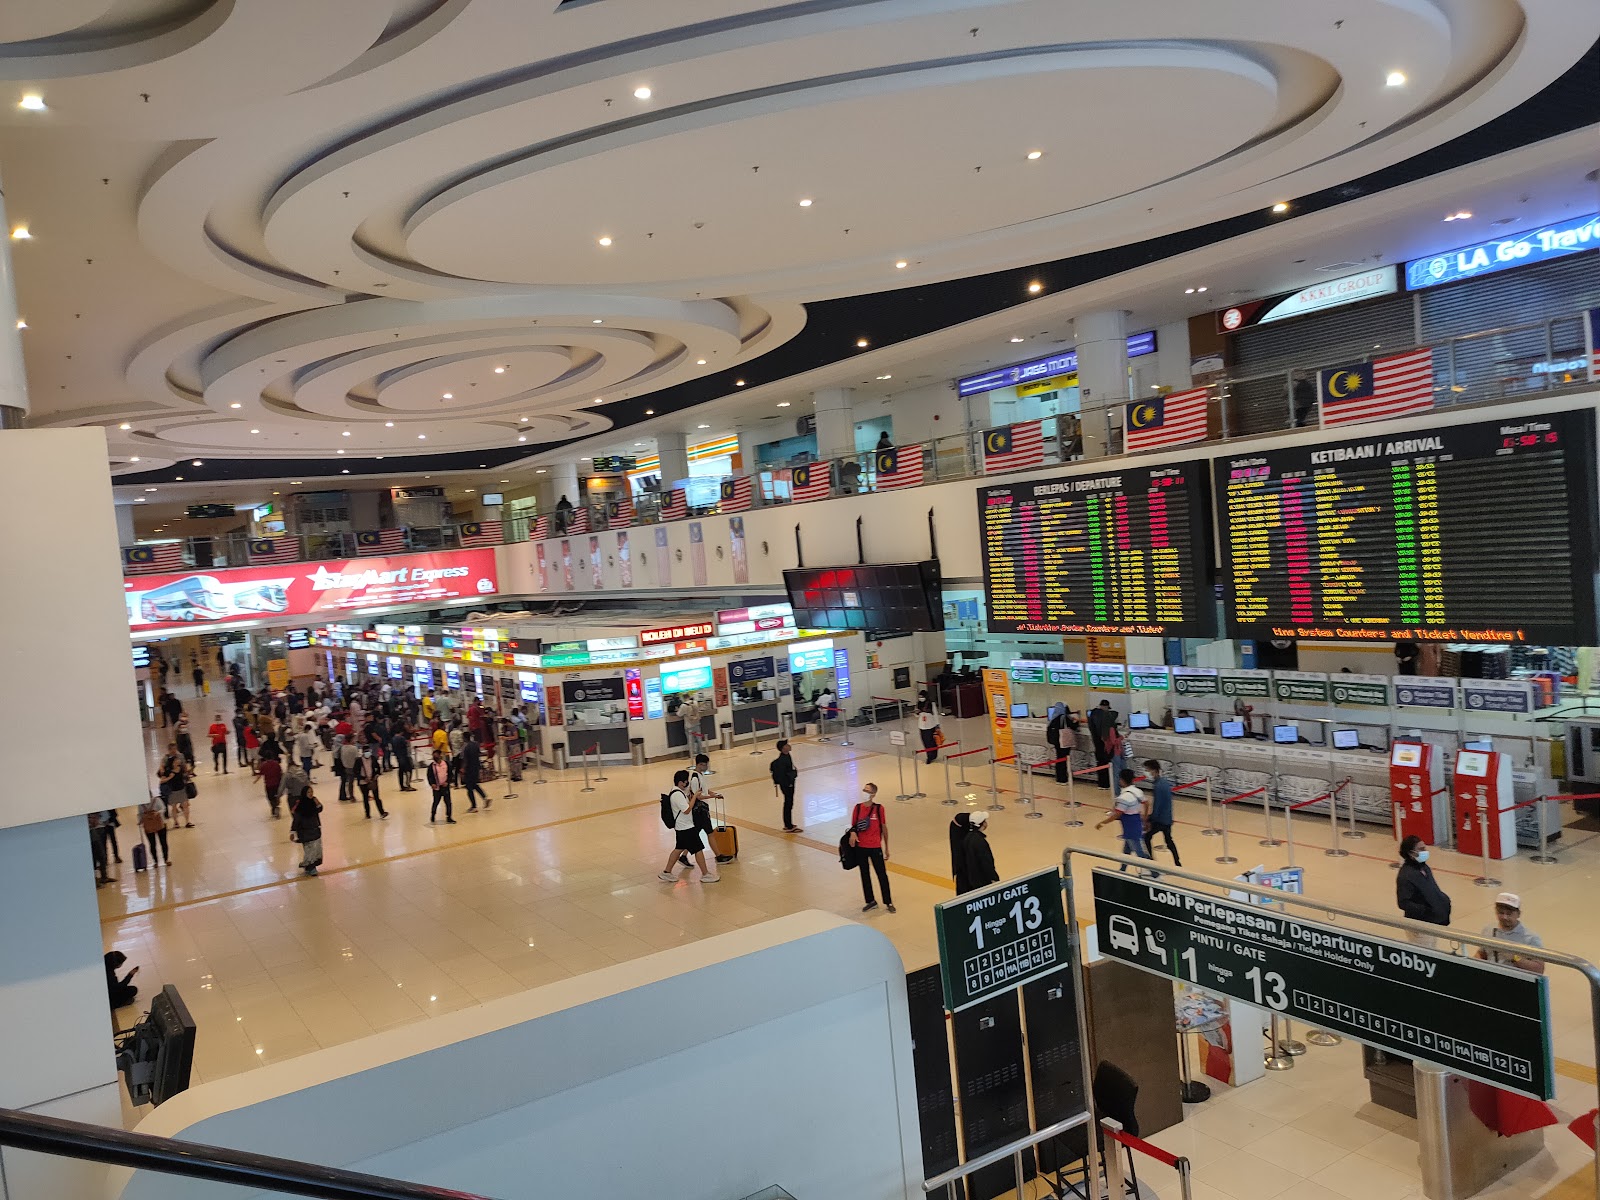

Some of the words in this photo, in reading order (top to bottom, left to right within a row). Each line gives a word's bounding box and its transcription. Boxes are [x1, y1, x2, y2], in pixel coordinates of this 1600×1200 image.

[1457, 248, 1490, 272] LA
[1496, 241, 1532, 261] Go
[1300, 287, 1336, 304] KKKL
[1338, 273, 1384, 294] GROUP
[1310, 445, 1374, 465] KETIBAAN
[1385, 436, 1444, 456] ARRIVAL
[1033, 481, 1070, 497] BERLEPAS
[1075, 476, 1122, 492] DEPARTURE
[411, 566, 469, 583] Express
[642, 629, 672, 642] BOLEH
[672, 628, 683, 638] DI
[1297, 627, 1333, 637] System
[1336, 628, 1386, 638] Counters
[1391, 628, 1410, 638] and
[1414, 629, 1457, 640] Ticket
[966, 896, 996, 914] PINTU
[1003, 884, 1029, 900] GATE
[968, 915, 984, 950] 1
[1009, 896, 1042, 934] 13
[984, 917, 1006, 930] Hingga
[1149, 887, 1181, 908] Lobi
[1185, 896, 1276, 934] Perlepasan
[1280, 920, 1286, 935] /
[1290, 922, 1374, 958] Departure
[1378, 945, 1436, 978] Lobby
[970, 962, 974, 971] 1
[982, 958, 988, 966] 2
[995, 953, 1000, 962] 3
[1007, 948, 1013, 956] 4
[1020, 944, 1025, 952] 5
[1032, 939, 1037, 947] 6
[1044, 934, 1049, 942] 7
[1190, 930, 1224, 949] PINTU
[1234, 944, 1266, 962] GATE
[1194, 915, 1237, 934] Pemegang
[1237, 927, 1260, 940] Tiket
[1260, 932, 1292, 949] Sahaja
[1297, 942, 1323, 958] Ticket
[1324, 948, 1352, 965] Holder
[1354, 959, 1375, 972] Only
[972, 980, 977, 988] 8
[984, 975, 990, 984] 9
[994, 969, 1004, 978] 10
[1006, 964, 1018, 974] 11A
[1019, 959, 1030, 969] 11B
[1032, 954, 1041, 964] 12
[1044, 950, 1052, 958] 13
[1181, 947, 1198, 983] 1
[1244, 966, 1288, 1011] 13
[1208, 962, 1234, 978] hingga
[1216, 974, 1226, 984] to
[1300, 996, 1304, 1005] 1
[1313, 1000, 1320, 1010] 2
[1328, 1005, 1335, 1014] 3
[1343, 1010, 1350, 1018] 4
[1358, 1014, 1366, 1024] 5
[1374, 1019, 1381, 1029] 6
[1390, 1024, 1397, 1034] 7
[1407, 1030, 1414, 1039] 8
[1424, 1034, 1431, 1044] 9
[1438, 1039, 1451, 1050] 10
[1455, 1044, 1470, 1056] 11A
[1474, 1050, 1489, 1062] 11B
[1494, 1056, 1507, 1069] 12
[1513, 1061, 1526, 1074] 13
